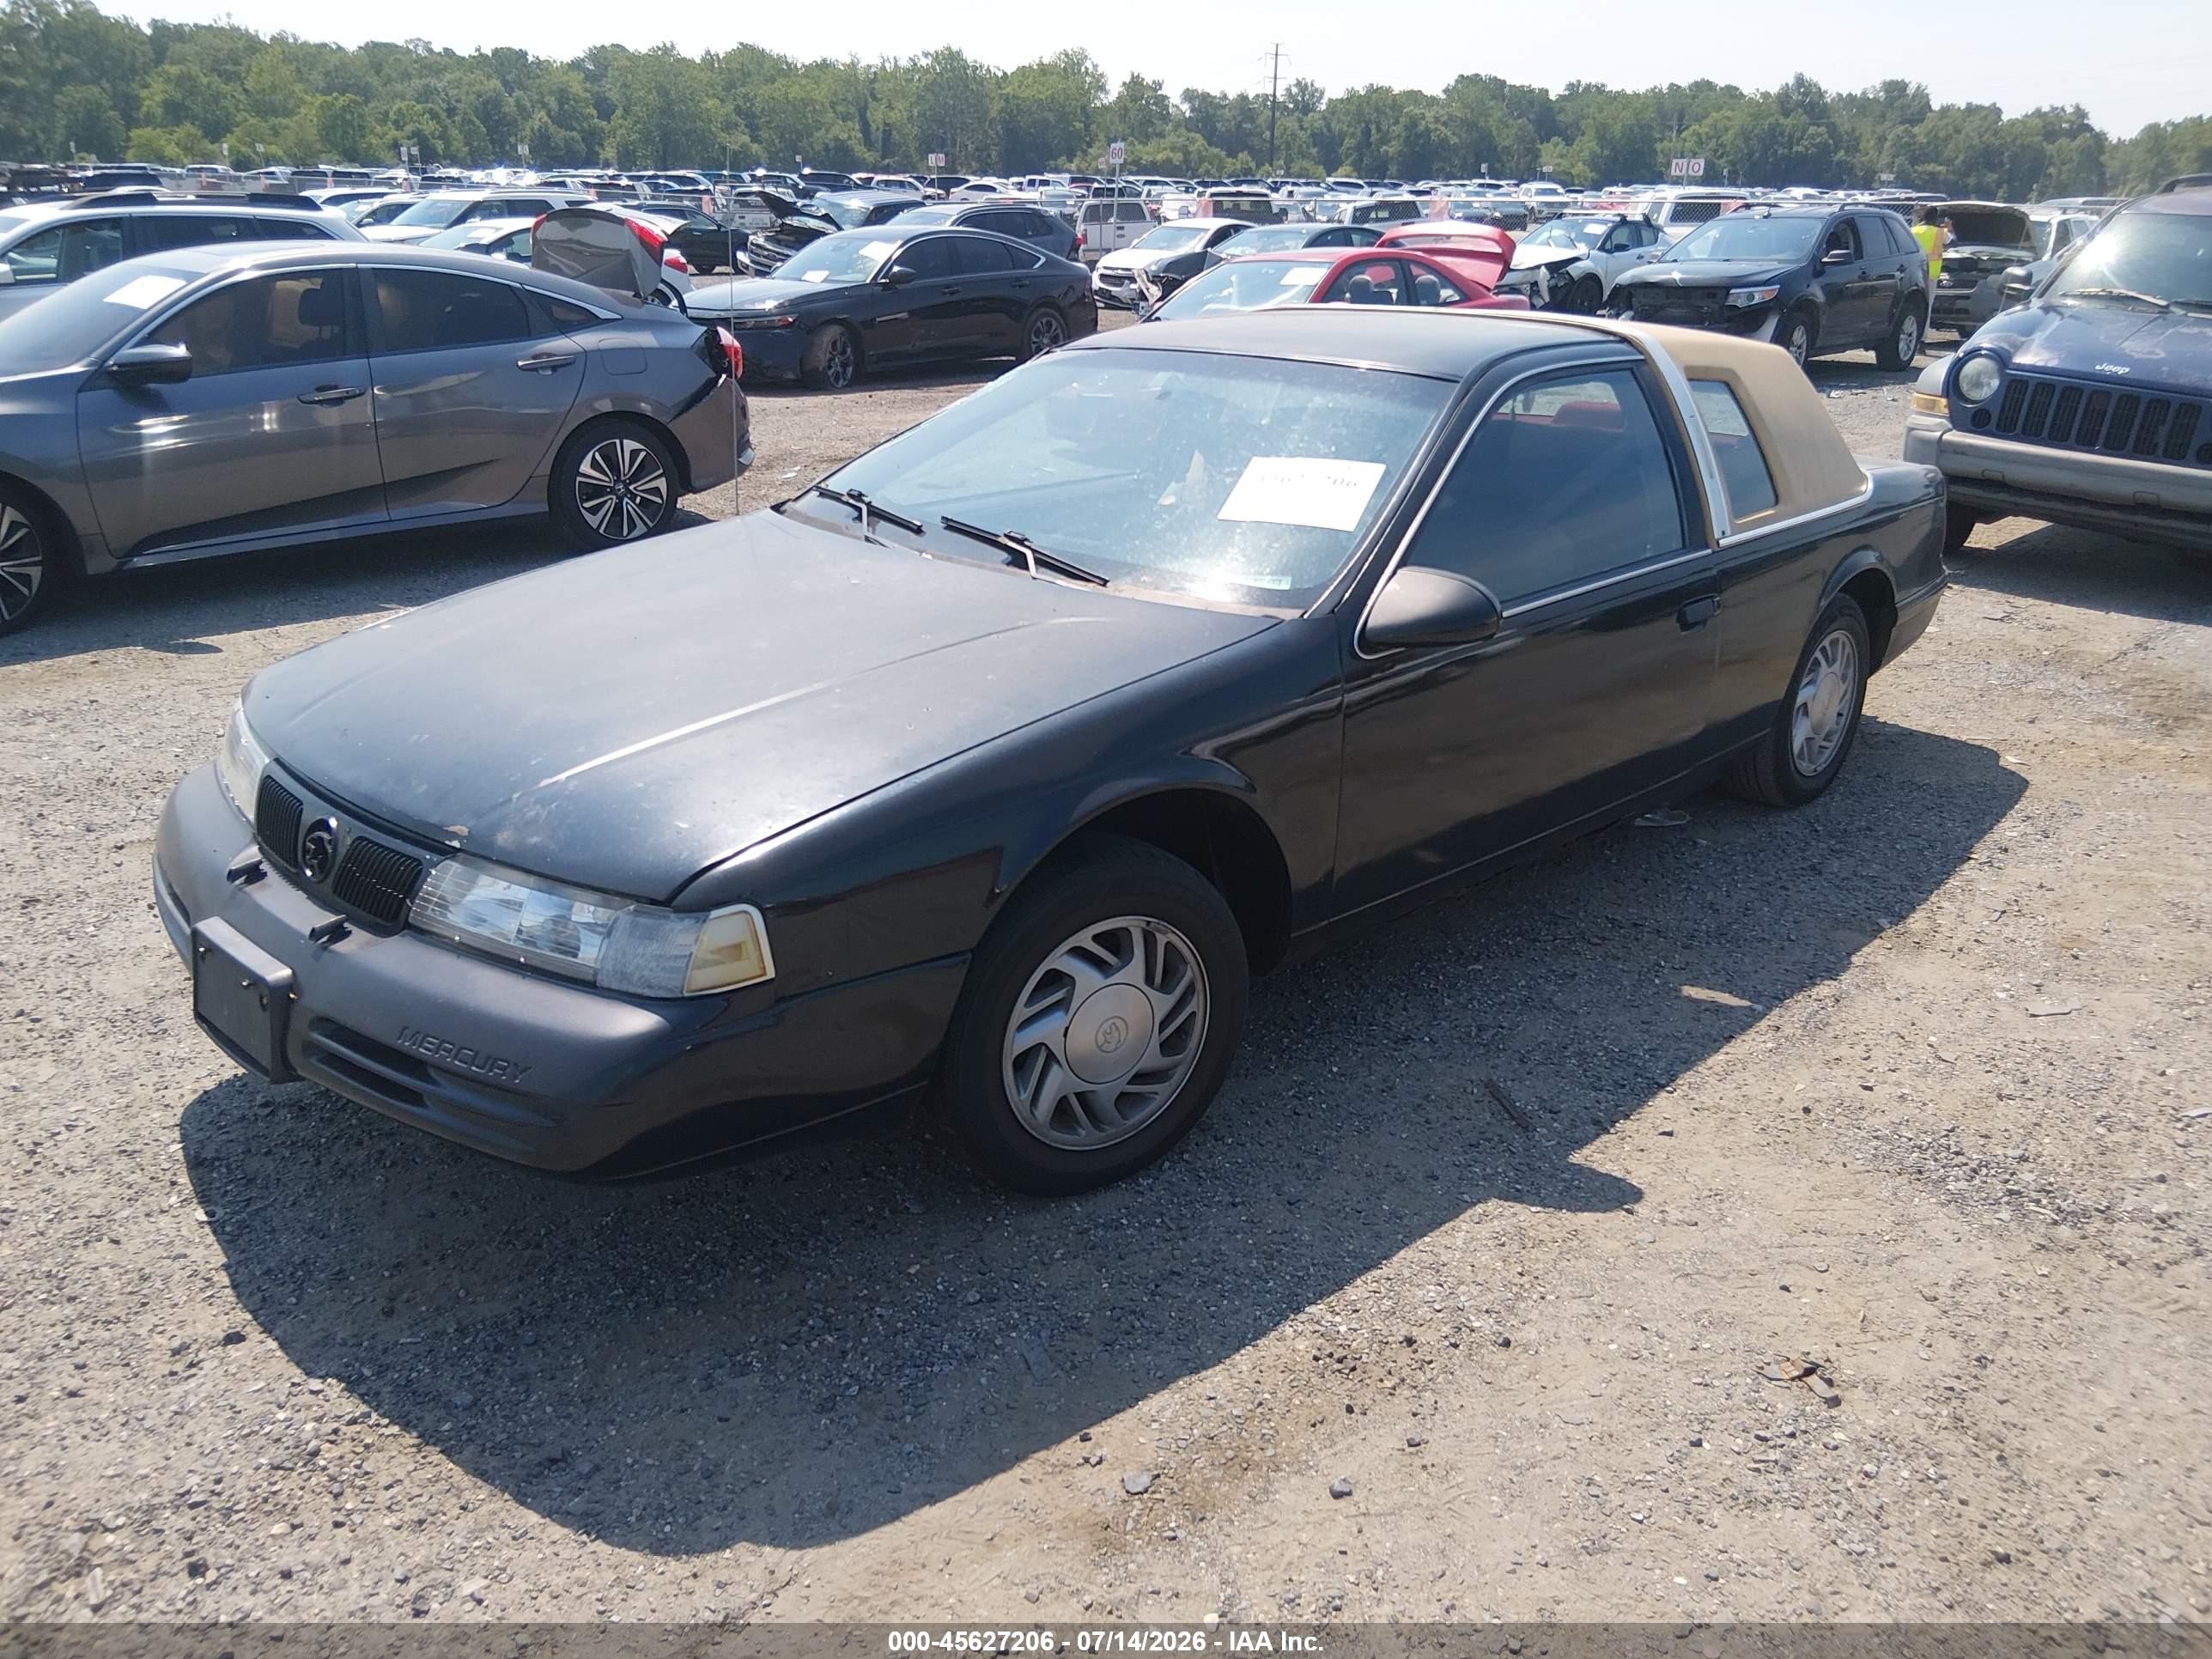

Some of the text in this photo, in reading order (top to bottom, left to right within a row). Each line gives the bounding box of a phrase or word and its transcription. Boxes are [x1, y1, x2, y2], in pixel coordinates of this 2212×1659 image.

[1111, 148, 1123, 159] 60
[2095, 363, 2130, 375] Jeep
[397, 1025, 532, 1084] MERCURY
